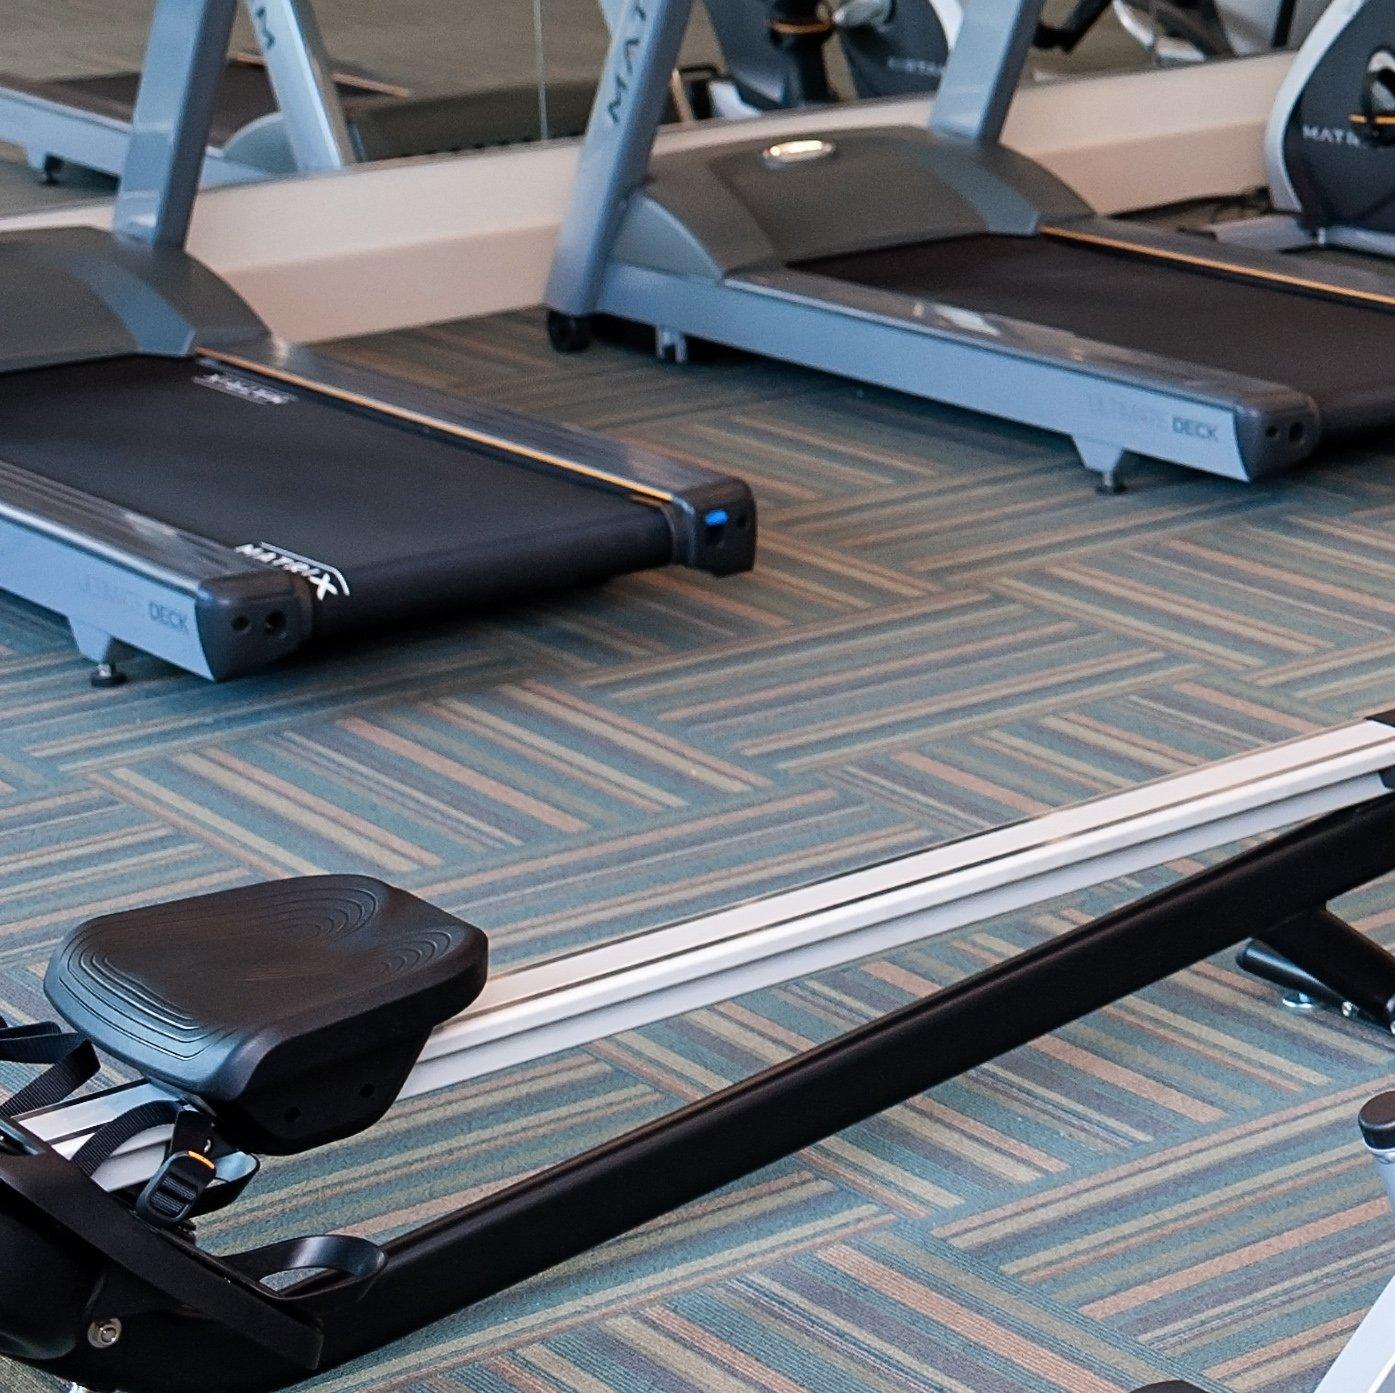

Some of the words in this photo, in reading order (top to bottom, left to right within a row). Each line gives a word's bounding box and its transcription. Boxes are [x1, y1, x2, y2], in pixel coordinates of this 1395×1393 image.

[1172, 416, 1218, 442] DECK
[235, 543, 338, 601] MATRIX
[149, 601, 189, 634] DECK
